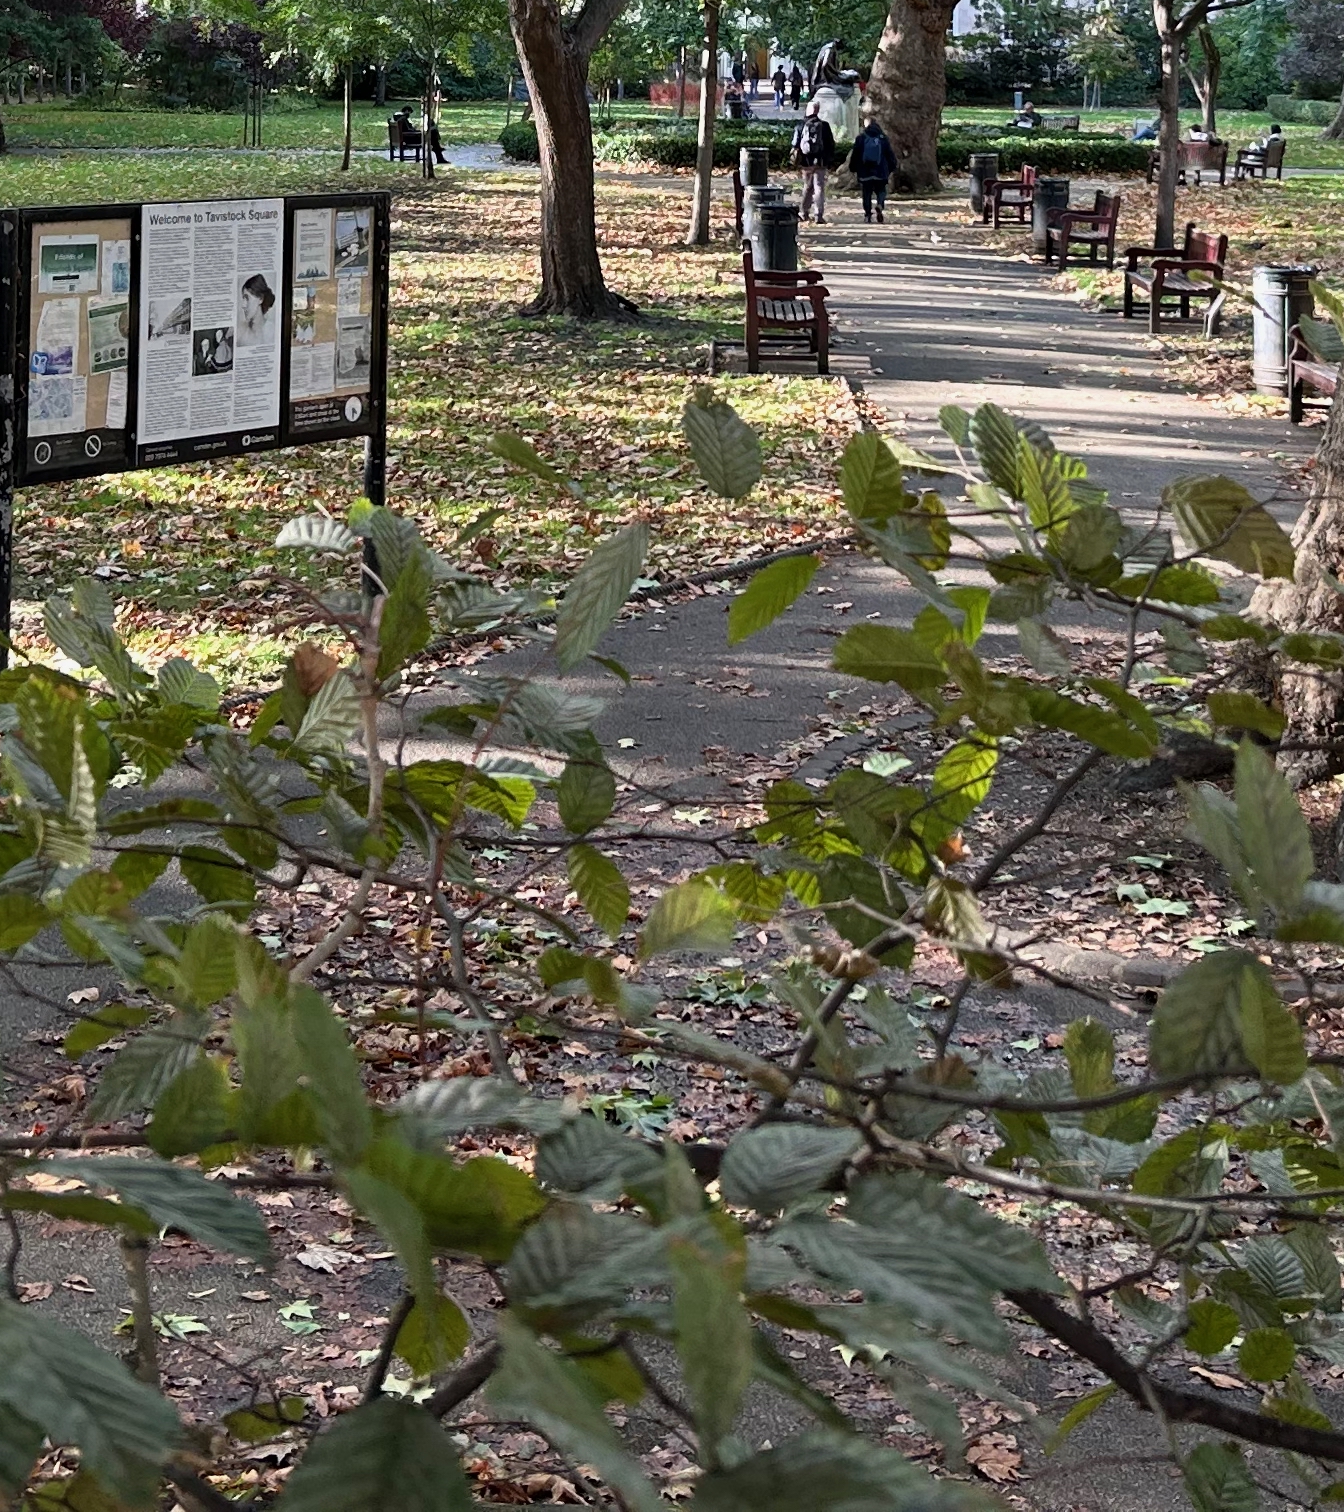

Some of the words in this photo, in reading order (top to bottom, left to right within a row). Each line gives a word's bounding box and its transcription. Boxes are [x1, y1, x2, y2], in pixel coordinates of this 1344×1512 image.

[149, 214, 192, 225] Welcome
[194, 213, 203, 223] to
[205, 210, 247, 223] Tavistock
[248, 209, 278, 221] Square
